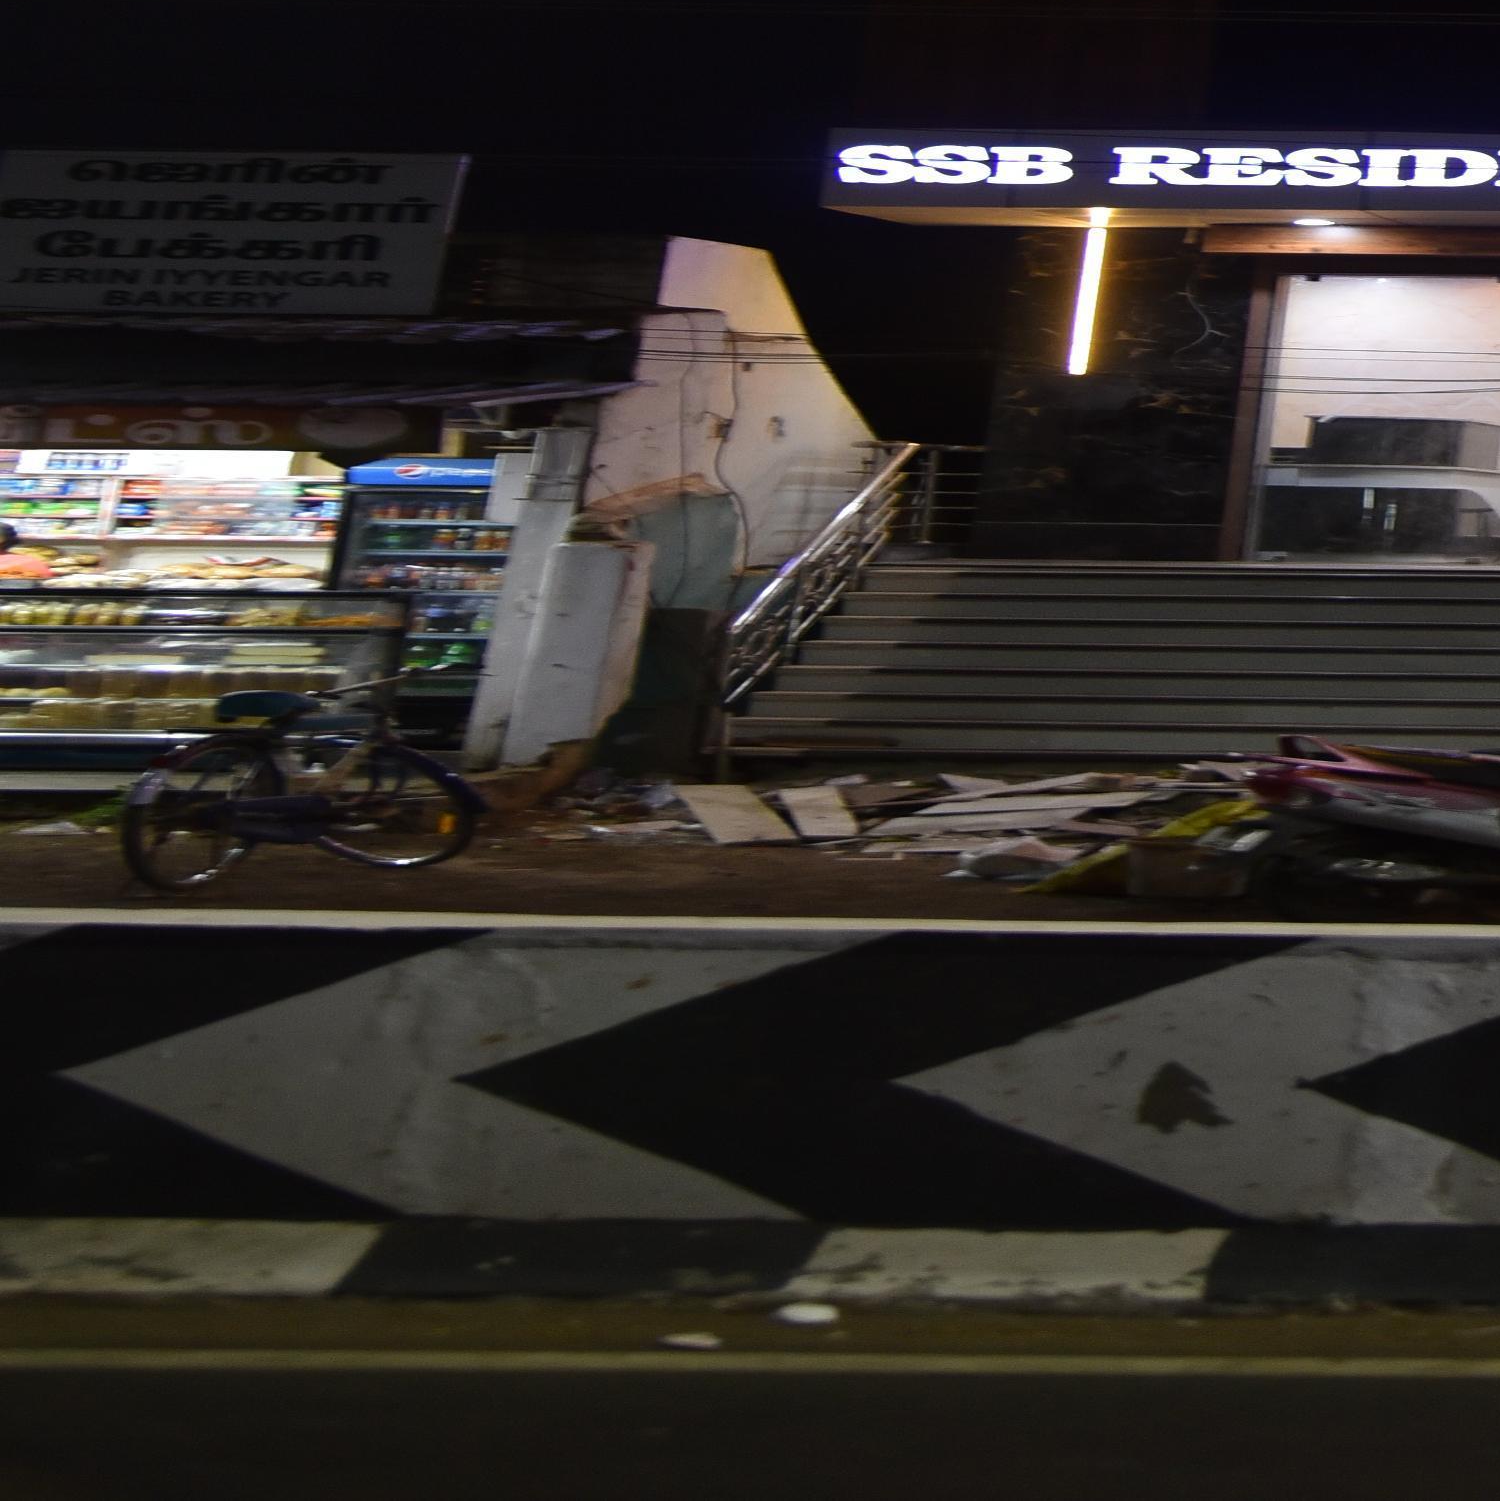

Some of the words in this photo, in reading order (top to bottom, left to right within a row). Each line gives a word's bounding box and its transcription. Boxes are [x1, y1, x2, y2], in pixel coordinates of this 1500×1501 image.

[837, 144, 1075, 185] SSB
[8, 267, 139, 284] JERIN
[152, 268, 391, 288] IYYENGAR
[101, 289, 290, 308] BAKERY
